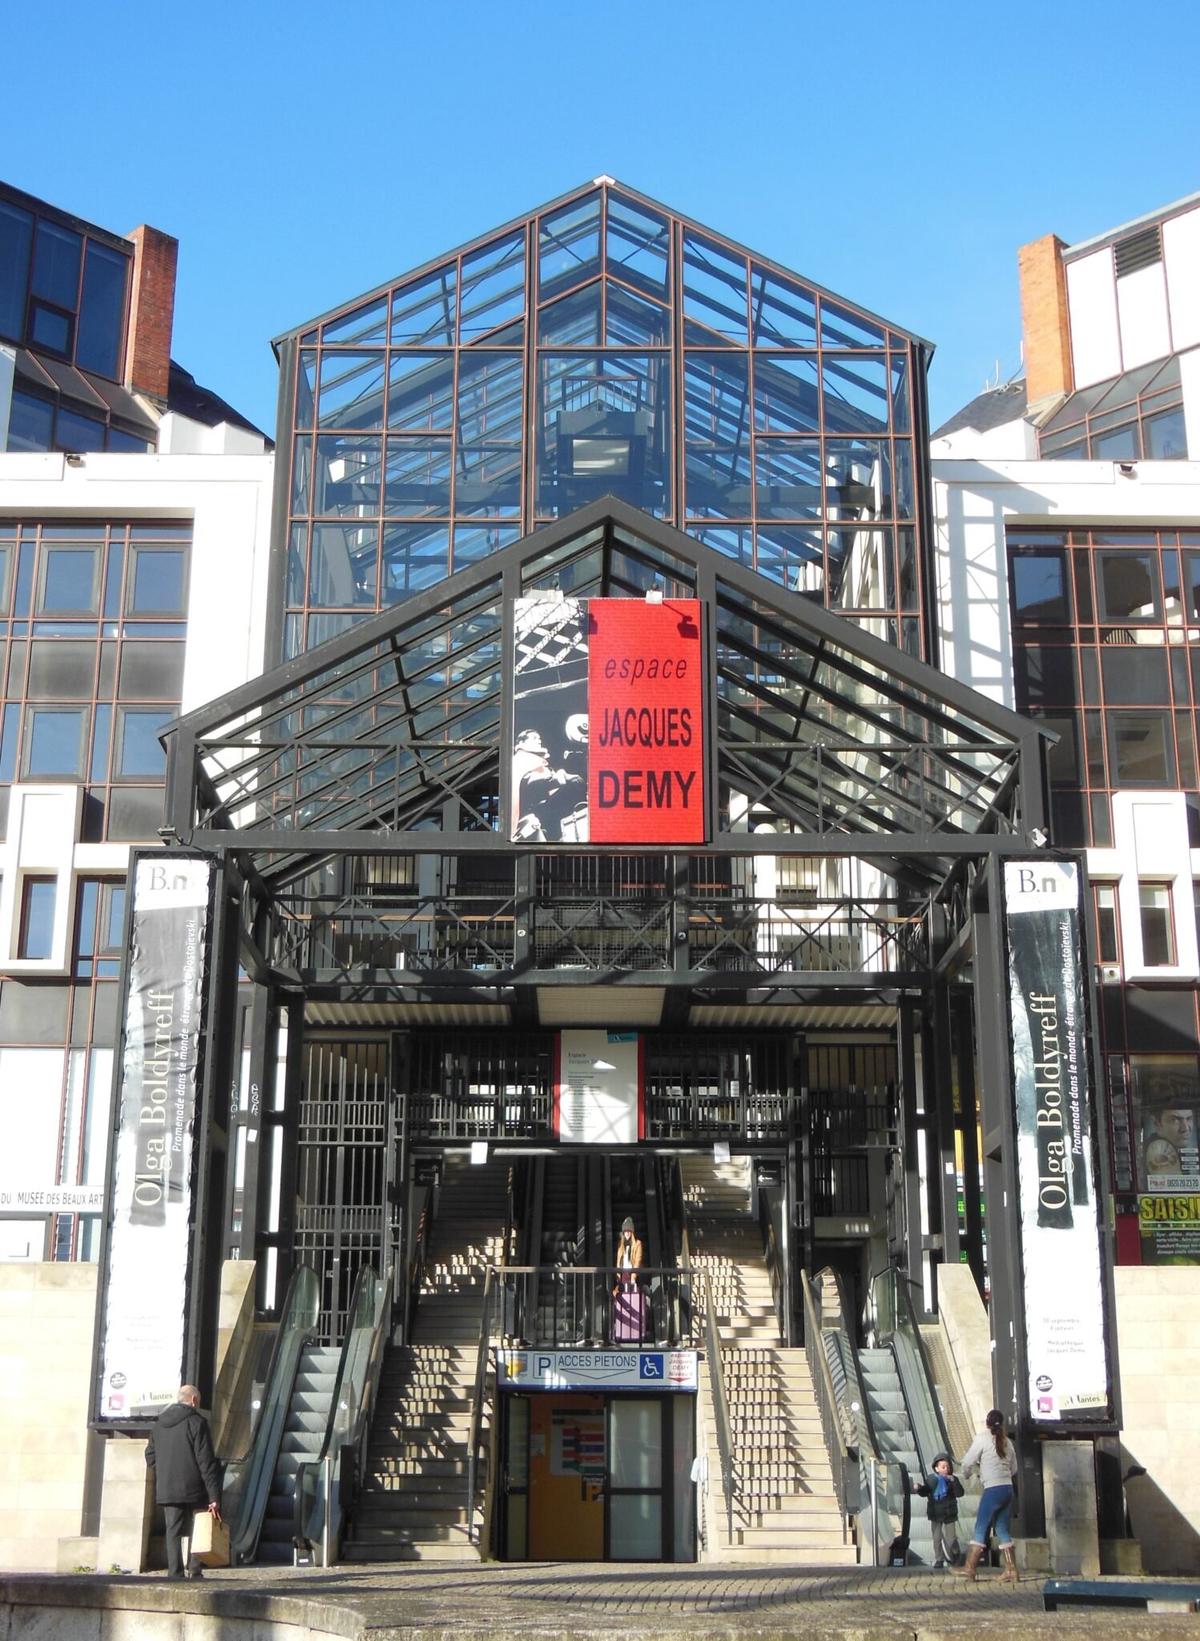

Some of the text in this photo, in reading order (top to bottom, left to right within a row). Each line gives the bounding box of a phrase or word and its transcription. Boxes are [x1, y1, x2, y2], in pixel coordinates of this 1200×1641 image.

[605, 659, 686, 684] espace
[598, 707, 693, 749] JACQUES
[597, 770, 696, 809] DEMY
[1018, 869, 1057, 893] B.n
[1060, 921, 1073, 975] Dostoïevski
[177, 1028, 190, 1060] monde
[1066, 1030, 1077, 1062] monde
[176, 1061, 186, 1071] le
[1068, 1063, 1078, 1074] le
[134, 989, 180, 1207] Olga Boldyreff
[175, 1073, 187, 1096] dans
[1069, 1075, 1079, 1099] dans
[1029, 992, 1075, 1210] Olga Boldyreff
[172, 1097, 185, 1153] Promenade
[1071, 1101, 1082, 1155] Promenade
[1, 1191, 104, 1205] DU MUSEE DES BEAUX ART
[538, 1355, 637, 1376] P ACCES PIETONS
